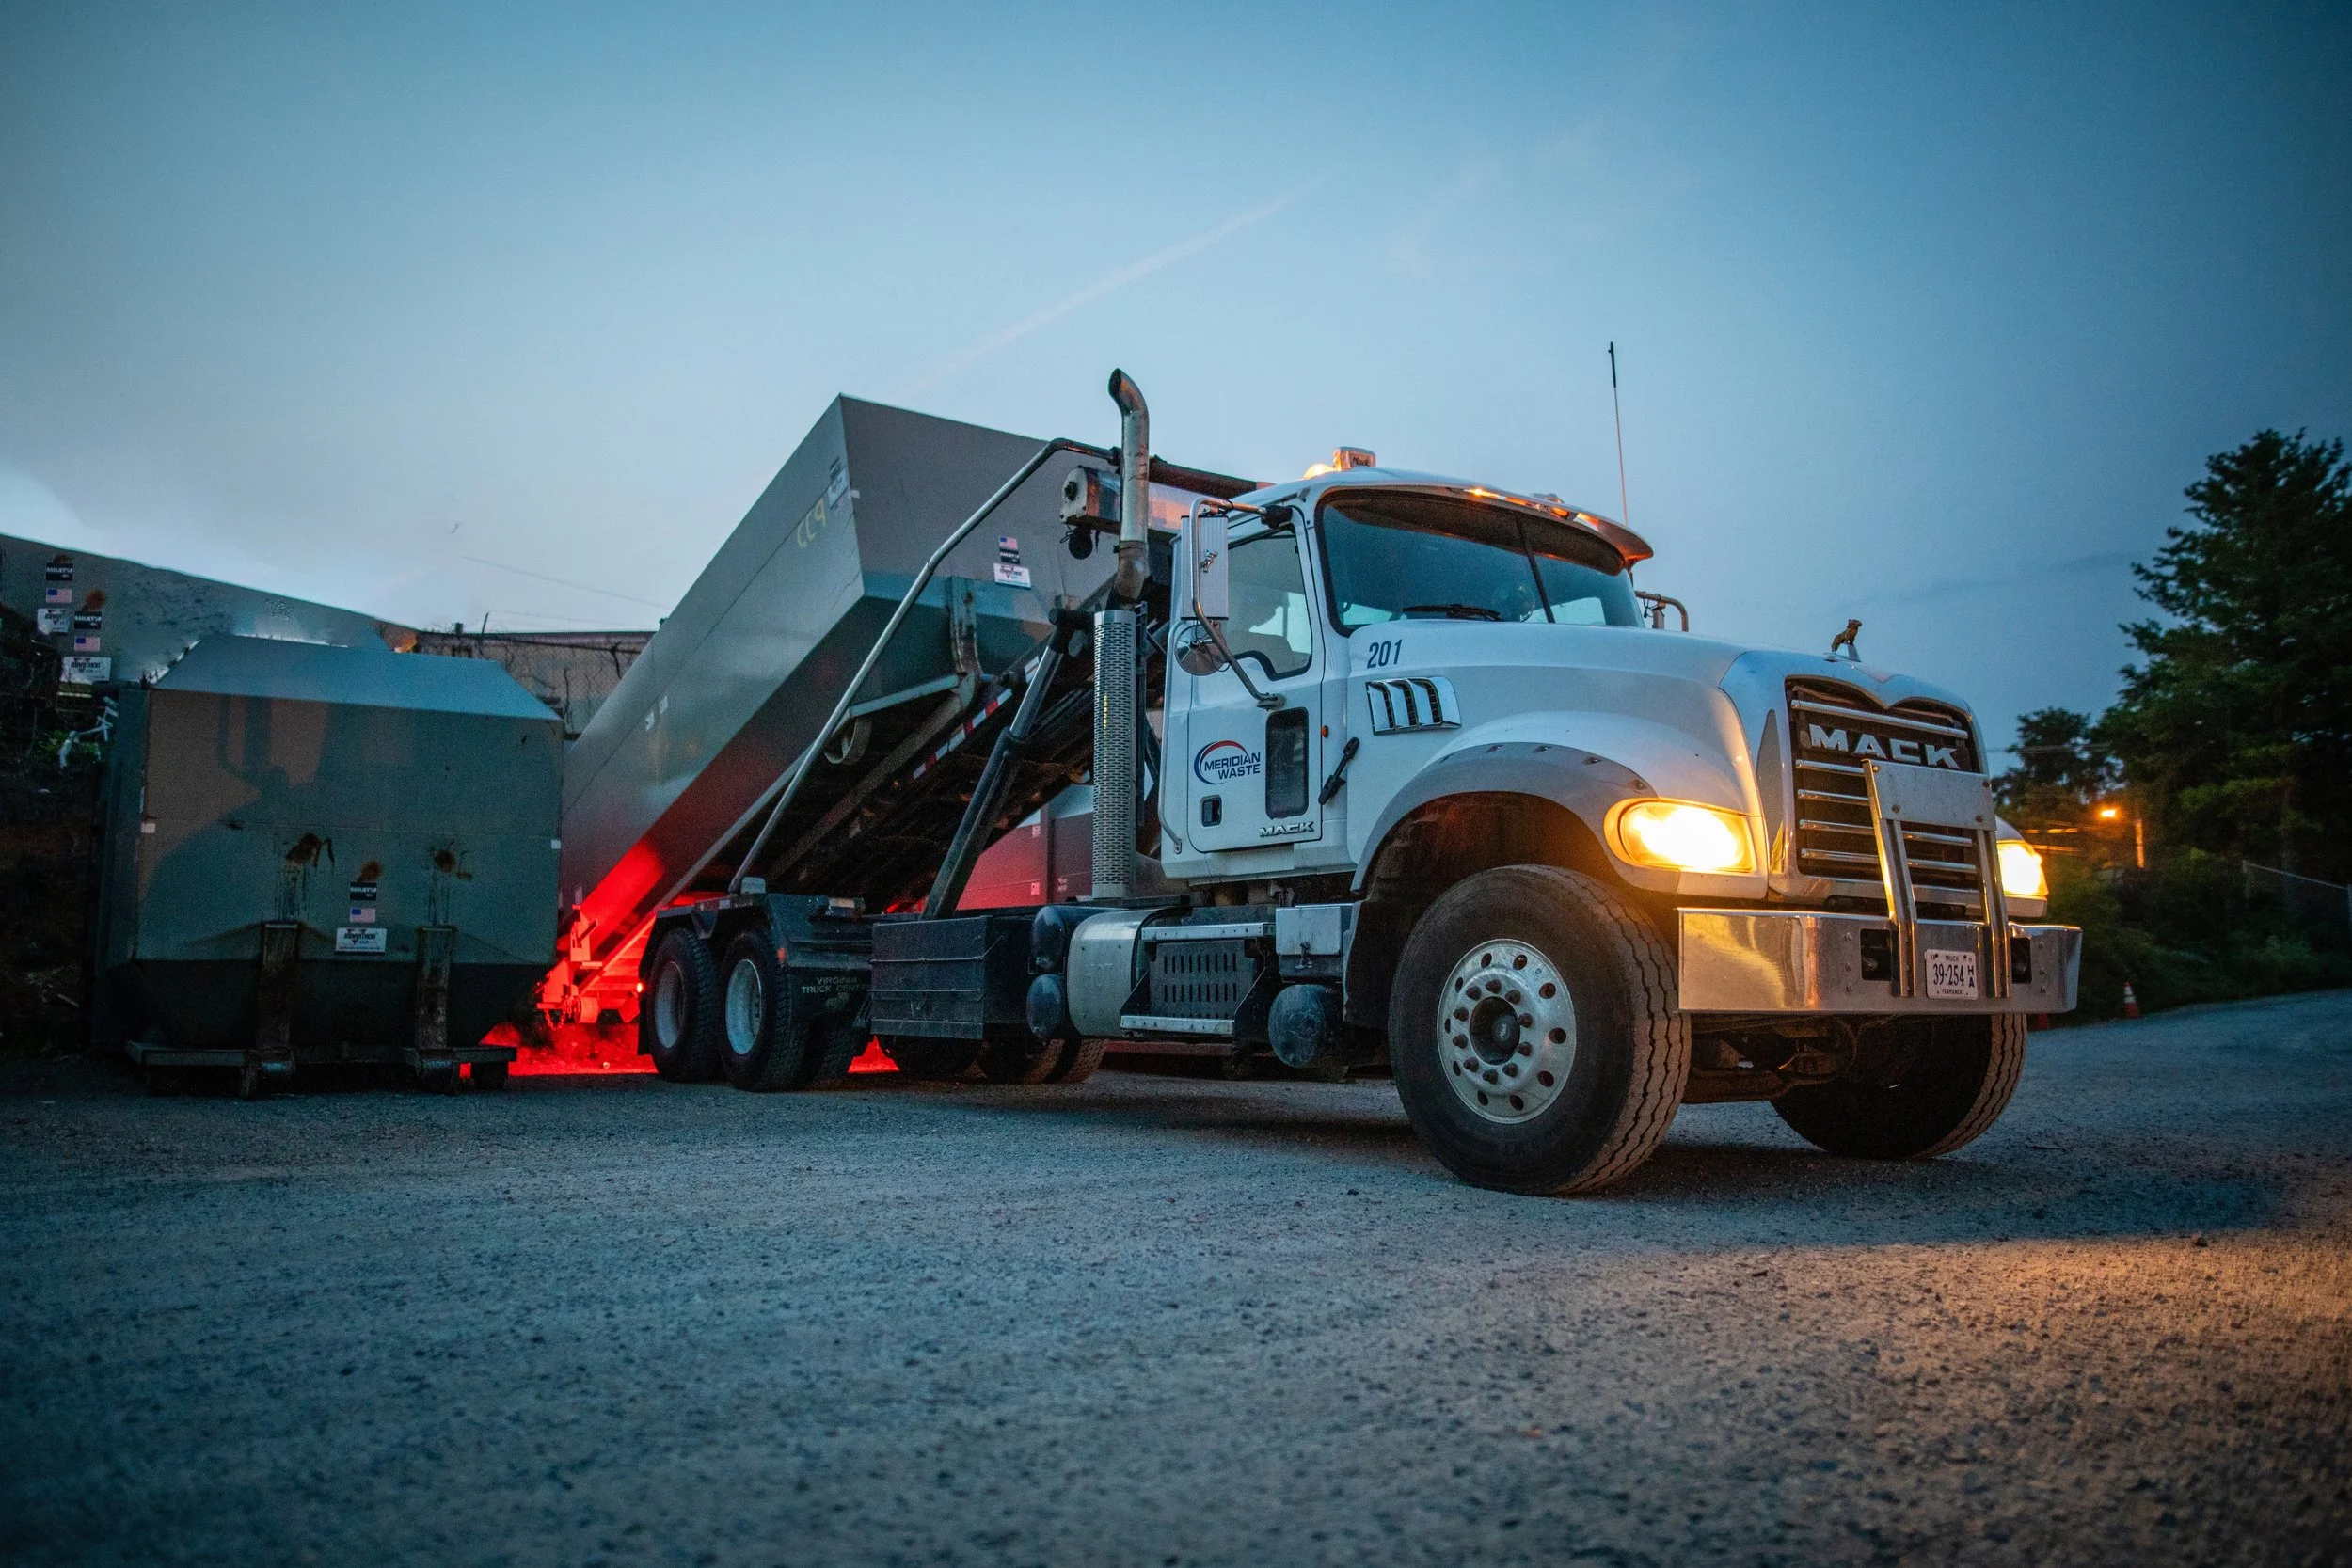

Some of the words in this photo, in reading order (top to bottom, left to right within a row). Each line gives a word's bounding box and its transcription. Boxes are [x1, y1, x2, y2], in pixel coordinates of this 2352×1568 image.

[1367, 639, 1403, 669] 201
[1809, 723, 1961, 770] MACK
[1204, 752, 1261, 772] MERIDIAN
[1217, 763, 1261, 780] WASTE
[1259, 820, 1315, 838] MACK
[1945, 954, 1960, 962] TRUCK
[801, 985, 832, 994] TRUCK
